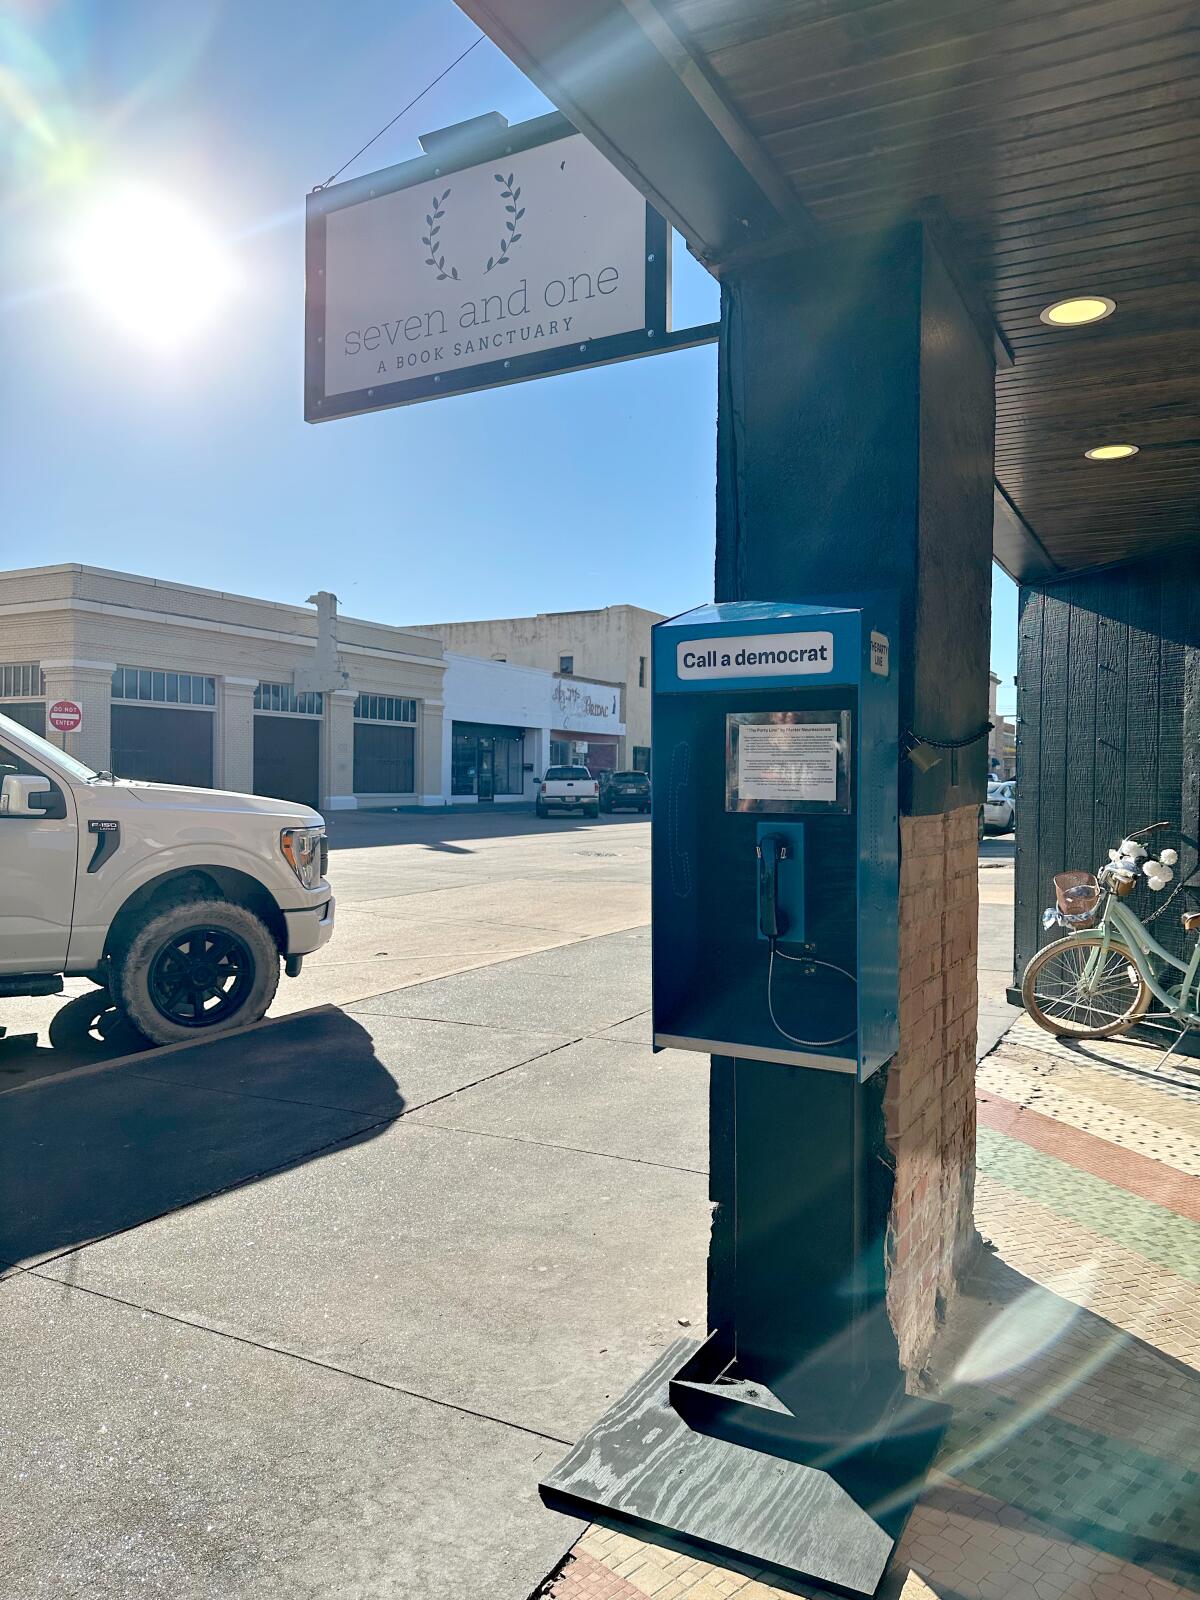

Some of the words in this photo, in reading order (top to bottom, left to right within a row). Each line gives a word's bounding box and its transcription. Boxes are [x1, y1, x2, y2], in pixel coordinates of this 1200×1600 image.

[343, 309, 447, 356] seven
[458, 279, 530, 329] and
[543, 265, 620, 308] one
[376, 360, 387, 374] A
[396, 346, 445, 370] BOOK
[453, 316, 575, 357] SANCTUARY
[683, 650, 717, 669] Call
[720, 654, 731, 667] a
[734, 645, 828, 667] democrat
